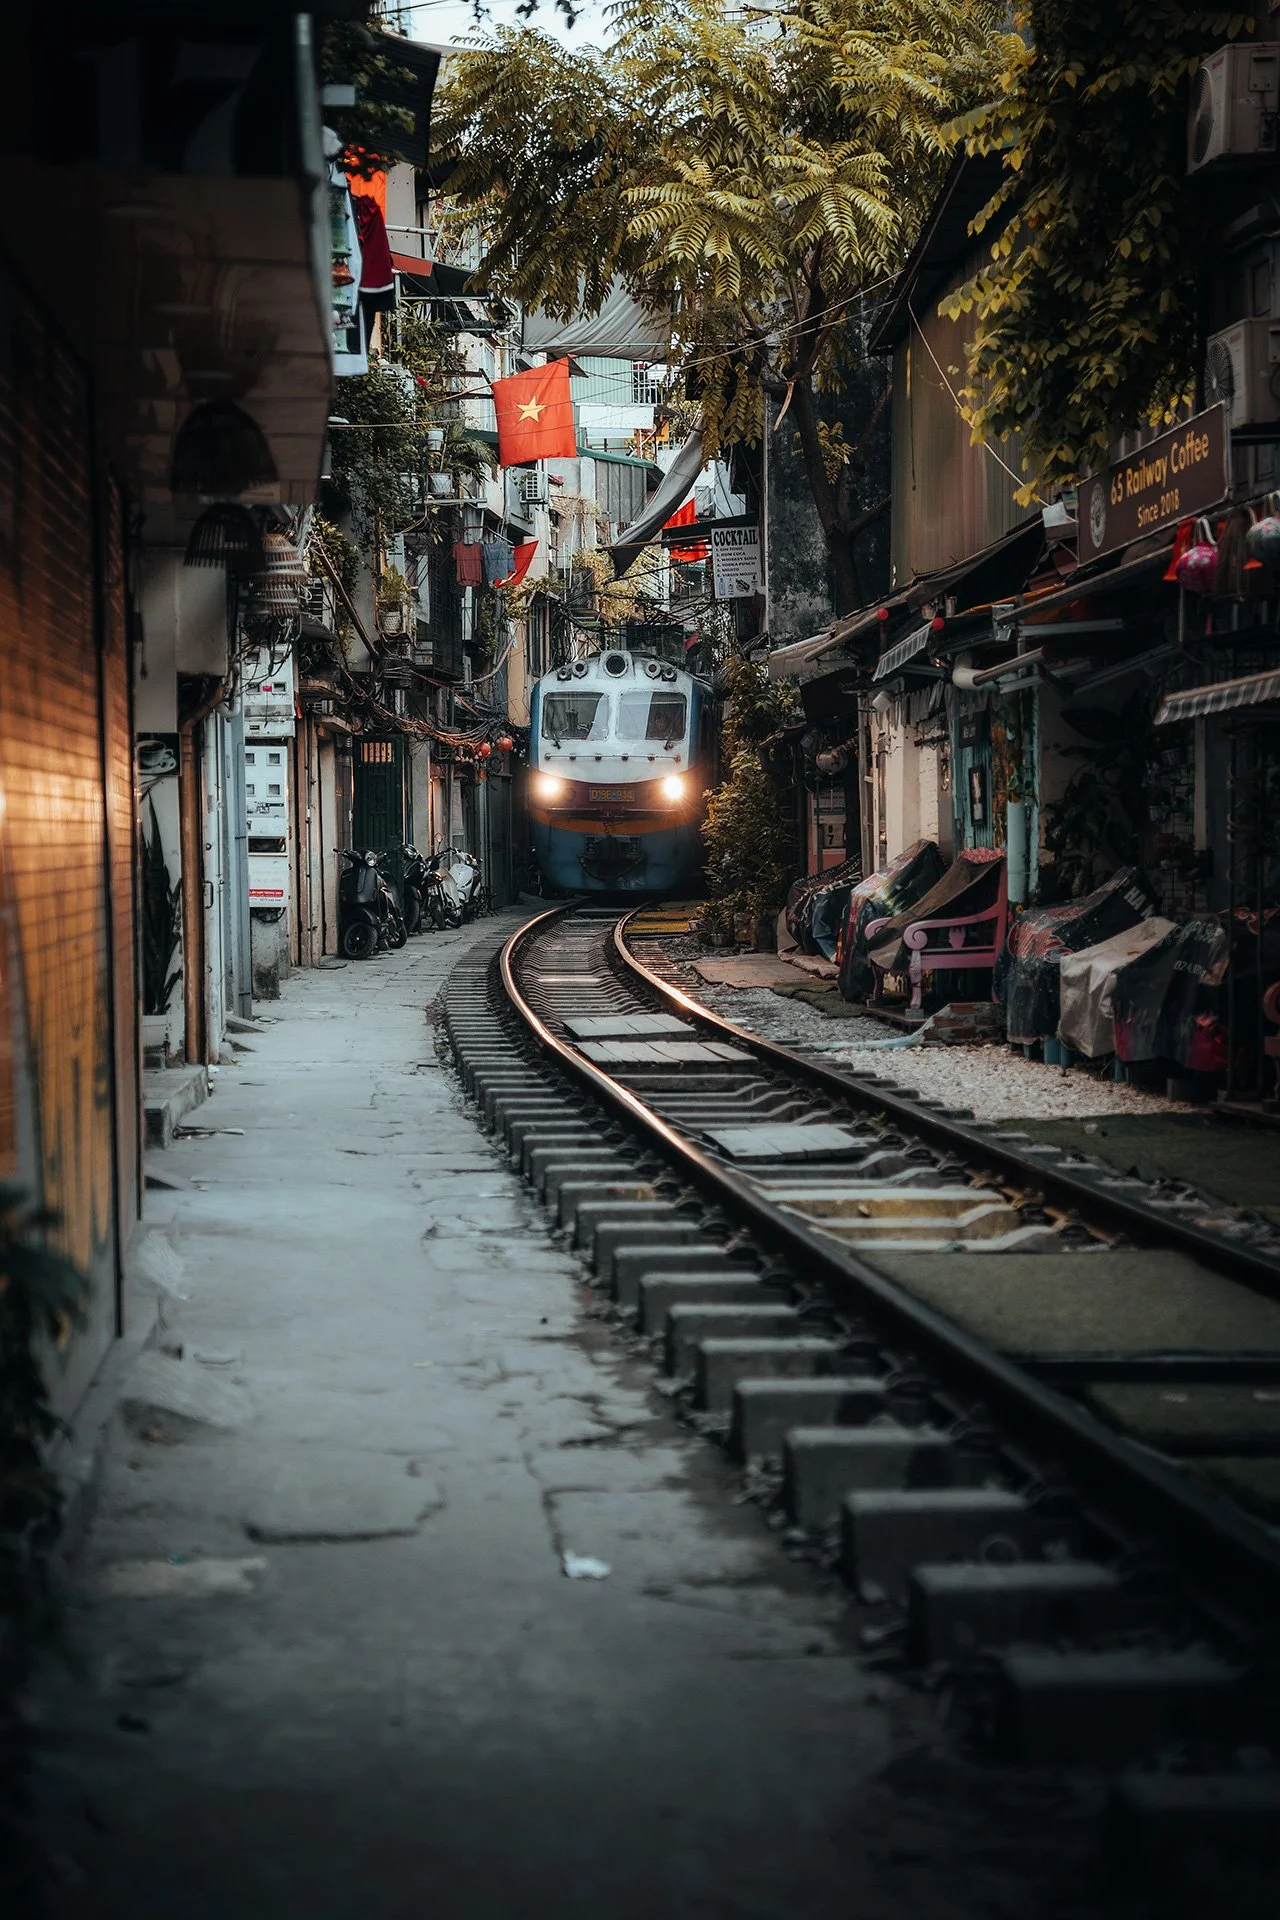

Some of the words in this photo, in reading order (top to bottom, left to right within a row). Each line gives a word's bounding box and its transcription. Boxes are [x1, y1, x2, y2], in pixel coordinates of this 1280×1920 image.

[1110, 473, 1124, 506] 65
[1125, 455, 1168, 497] Railway
[1170, 430, 1210, 474] Coffee
[1137, 503, 1159, 528] Since
[1160, 488, 1180, 517] 2018
[714, 529, 758, 547] COCKTAIL
